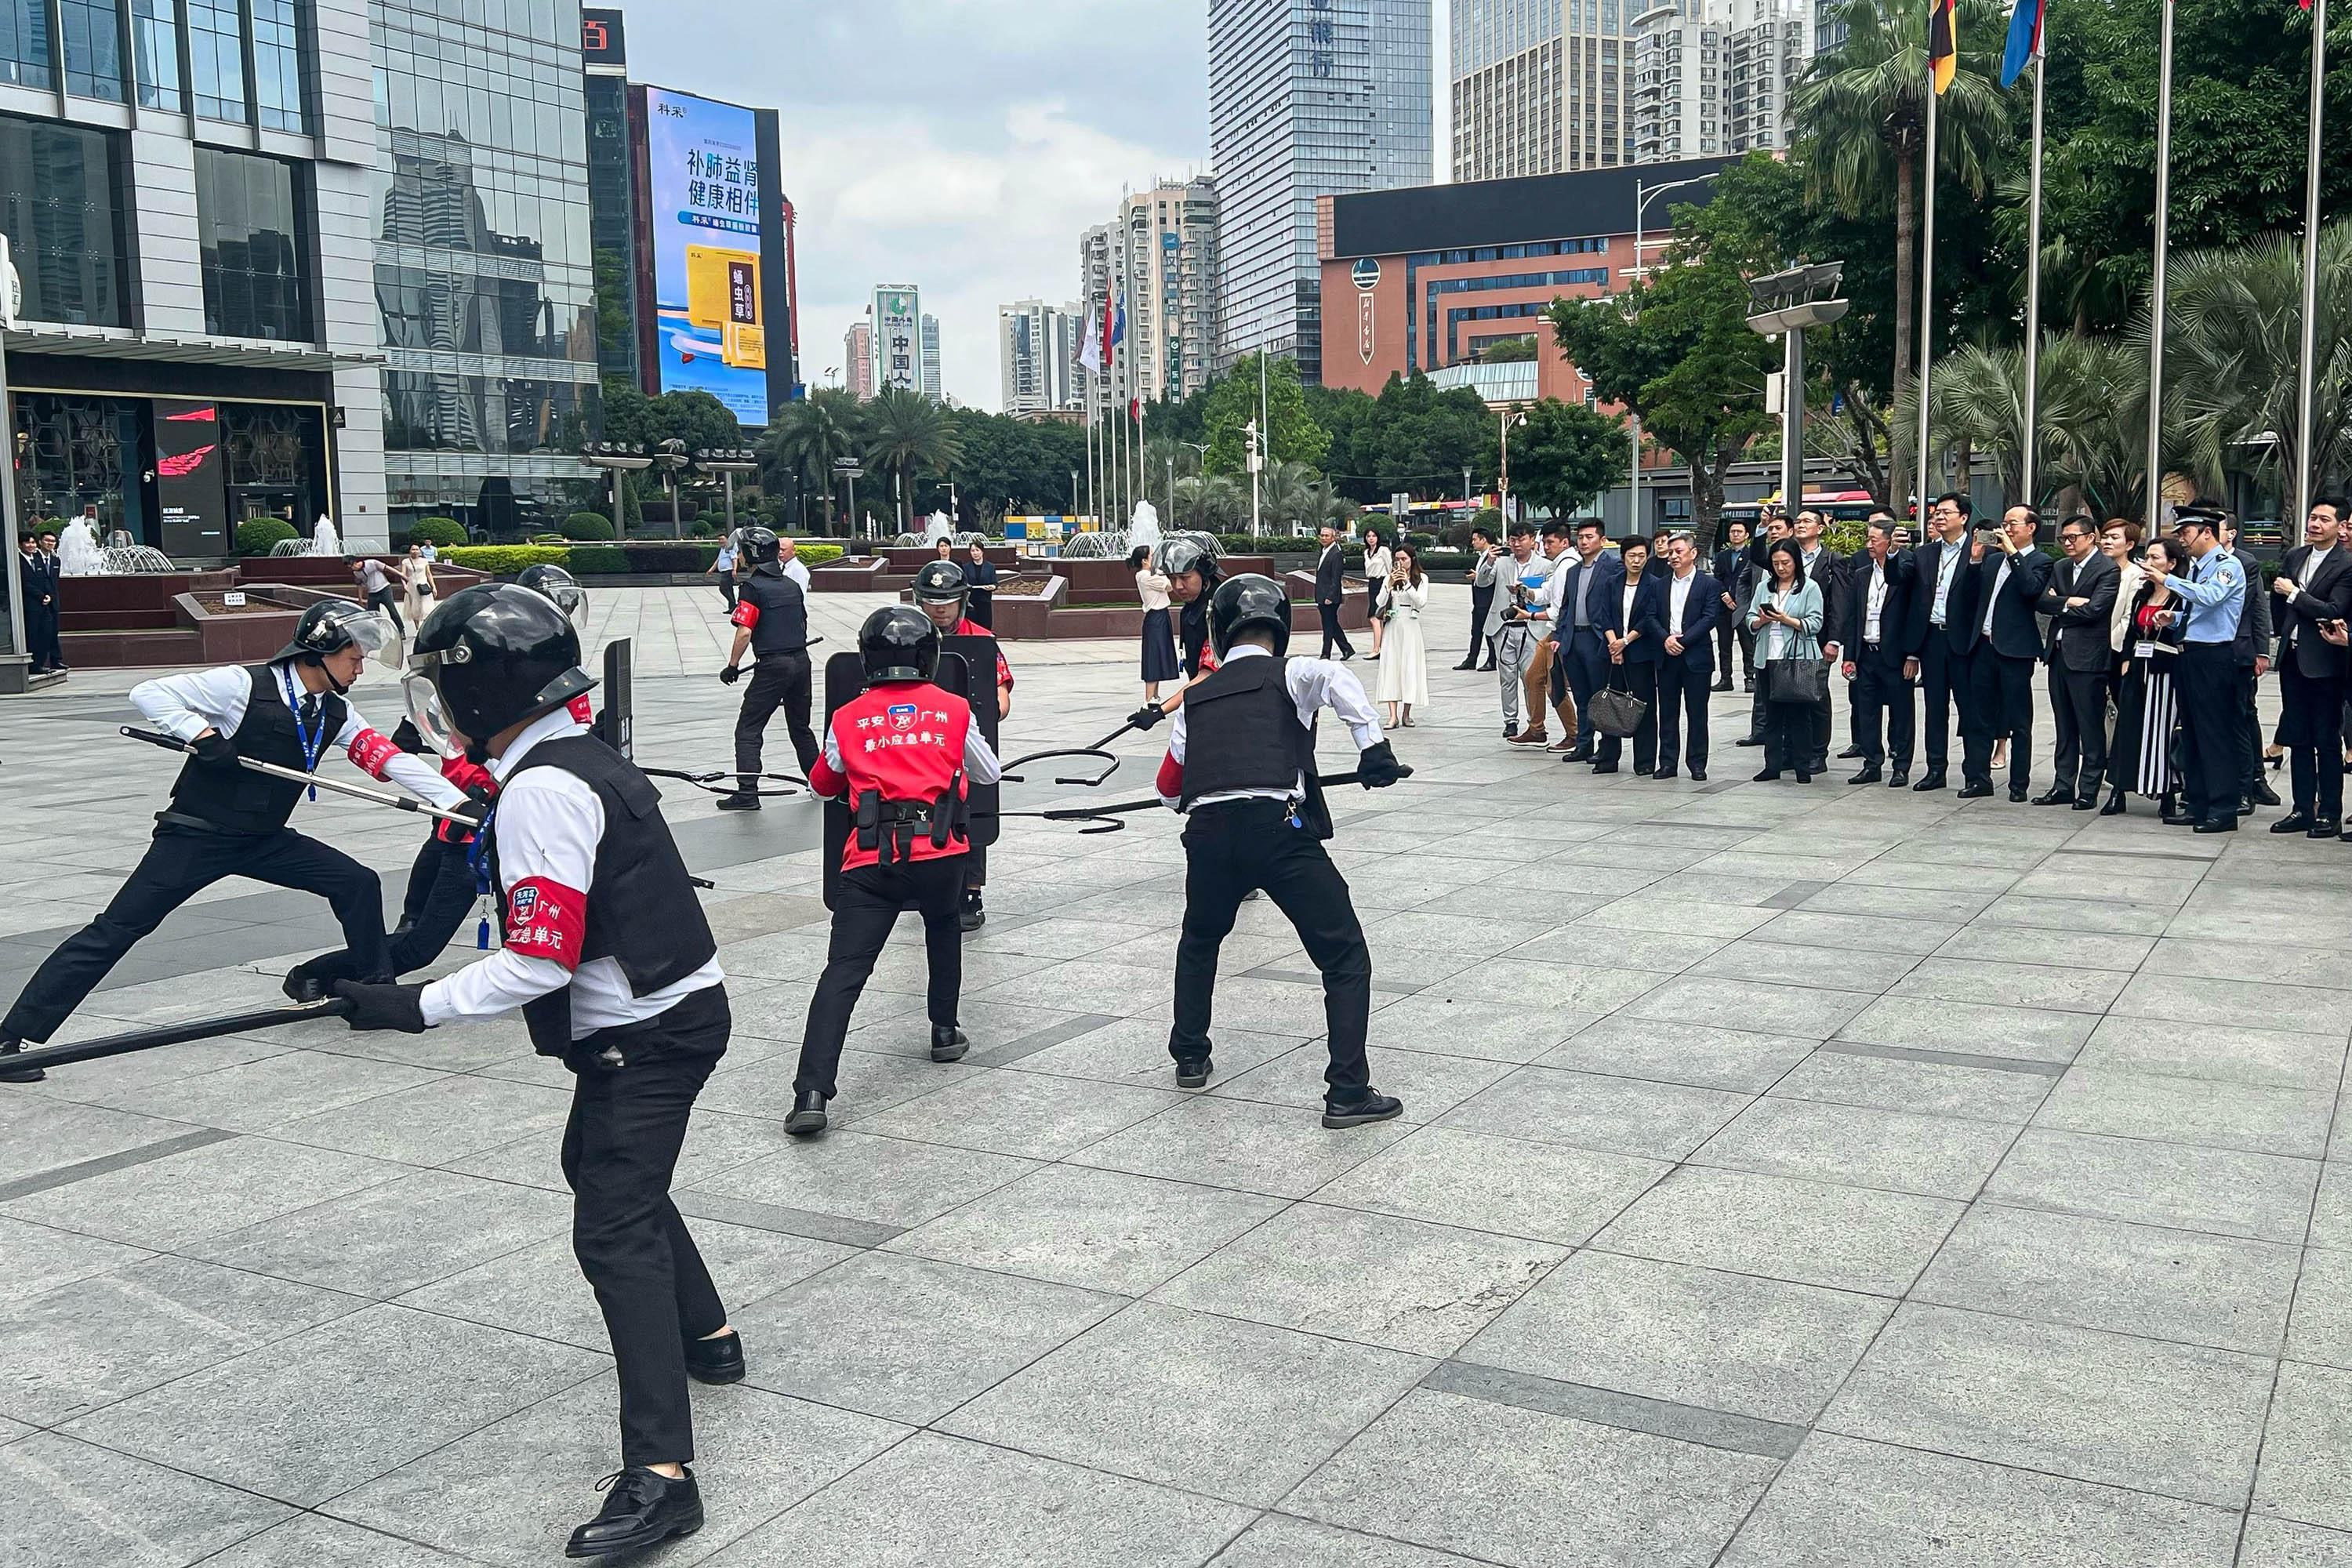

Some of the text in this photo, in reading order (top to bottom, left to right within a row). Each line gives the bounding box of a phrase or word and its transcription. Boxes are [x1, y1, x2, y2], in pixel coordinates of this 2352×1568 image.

[687, 148, 758, 187] 补肺益肾
[688, 179, 759, 216] 健康相伴
[892, 335, 911, 390] 中国人
[856, 715, 885, 730] 平安
[920, 710, 948, 724] 广州
[864, 731, 946, 753] 最小应急单元
[539, 900, 561, 920] 广州
